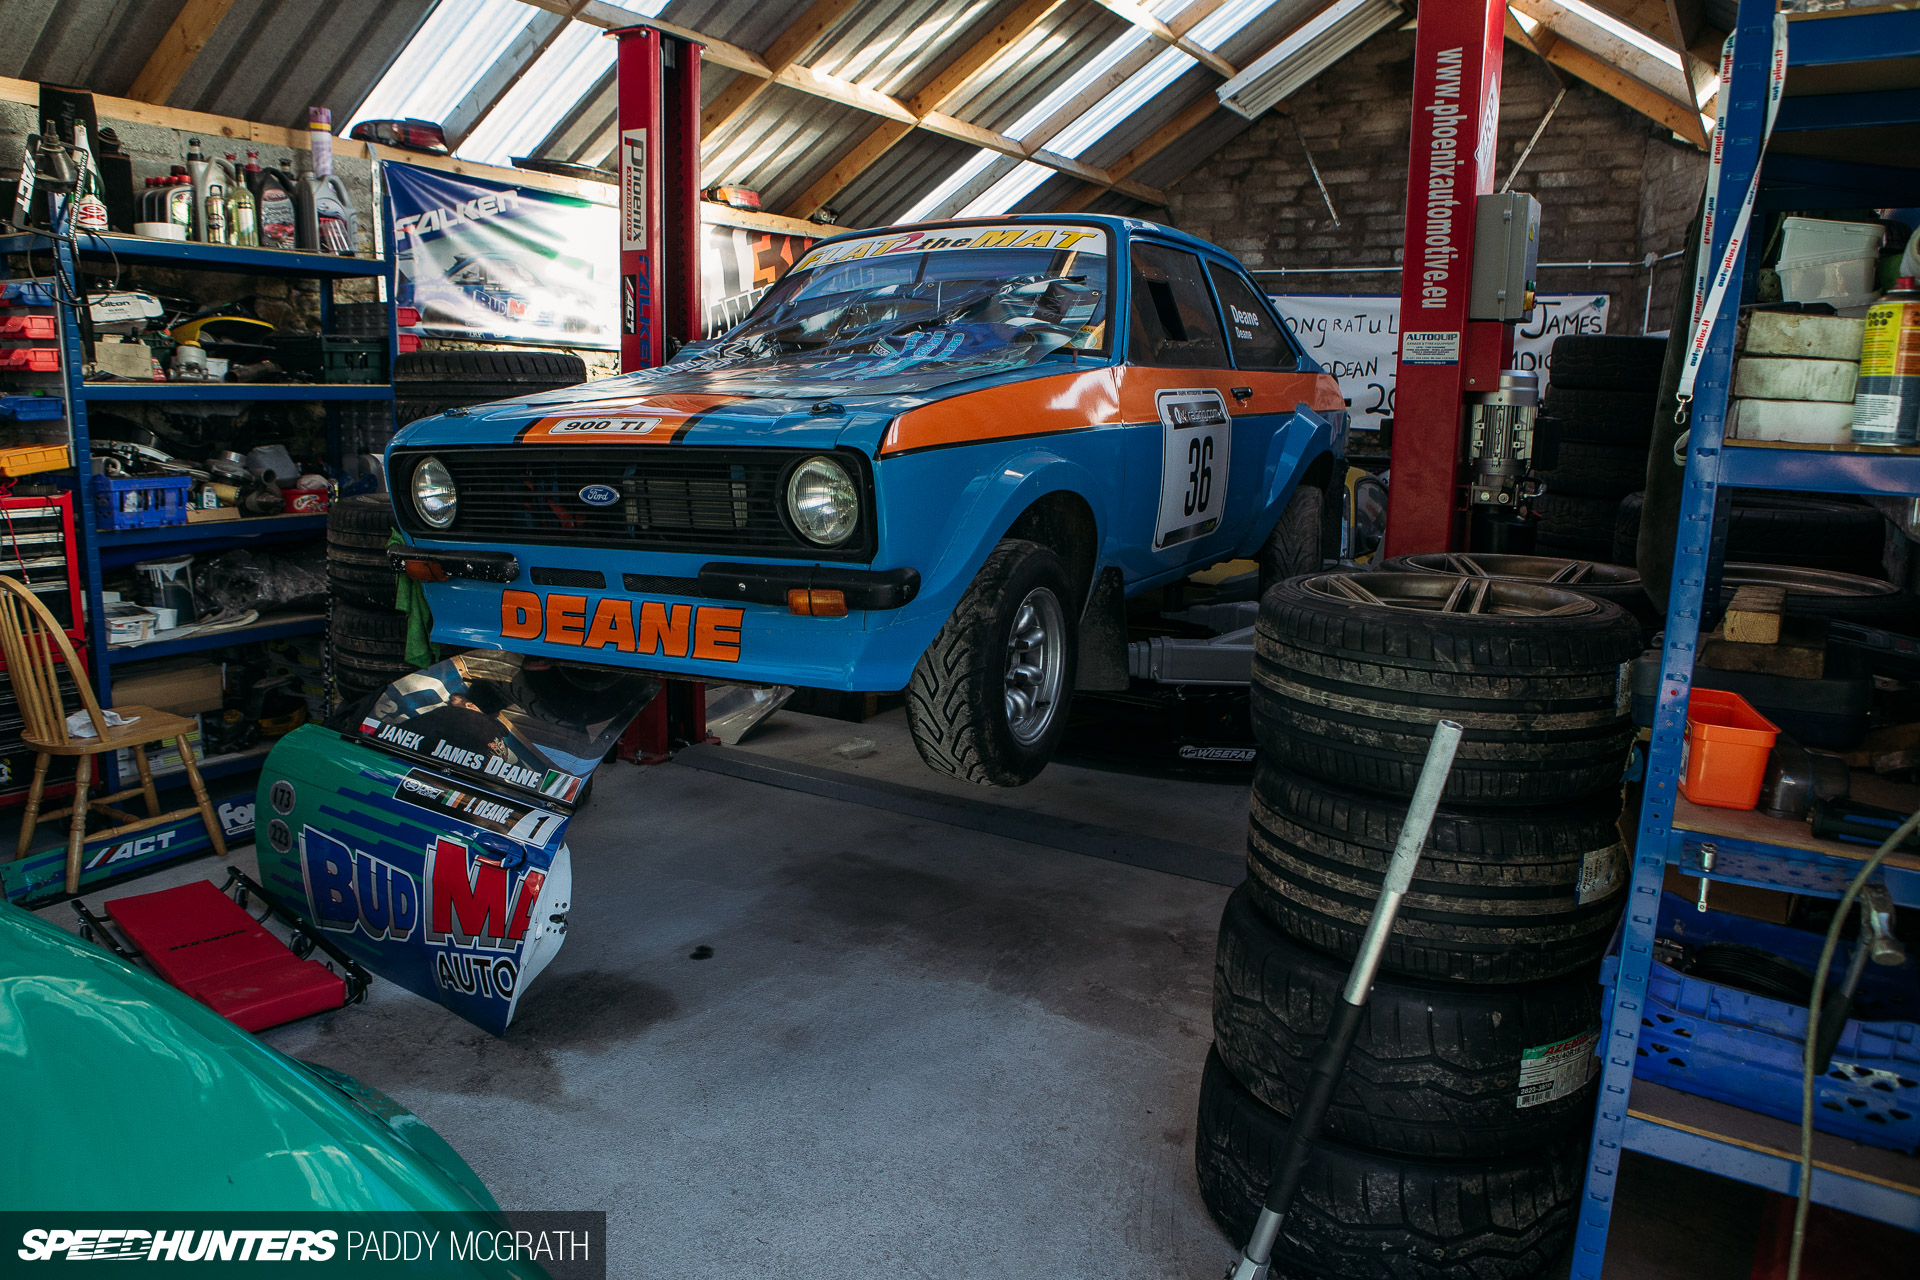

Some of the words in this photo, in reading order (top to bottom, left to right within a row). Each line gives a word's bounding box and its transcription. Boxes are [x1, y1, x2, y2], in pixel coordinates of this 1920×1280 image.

[1421, 46, 1467, 309] www.phoenixautomotive.eu
[393, 190, 521, 242] FALKEN
[638, 255, 650, 369] FALKE
[1229, 305, 1259, 327] Deane
[1520, 301, 1603, 340] JAMES
[1234, 326, 1253, 340] Deane
[1406, 333, 1458, 341] AUTOQUIP
[564, 421, 611, 431] 900
[620, 421, 647, 431] TI
[1184, 435, 1214, 518] 36
[587, 488, 609, 502] Ford
[500, 589, 745, 663] DEANE
[378, 724, 425, 751] JANEK
[431, 738, 485, 770] JAMES
[484, 755, 543, 788] DEANE
[1197, 747, 1257, 760] WISEFAB
[273, 786, 292, 809] 173
[464, 797, 477, 813] J.
[473, 799, 514, 824] DEANE
[271, 824, 289, 846] 223
[528, 815, 550, 840] 1
[105, 830, 176, 864] ACT
[299, 823, 418, 942] BUD
[437, 951, 519, 1001] AUTO
[1545, 1033, 1590, 1056] AZENIS
